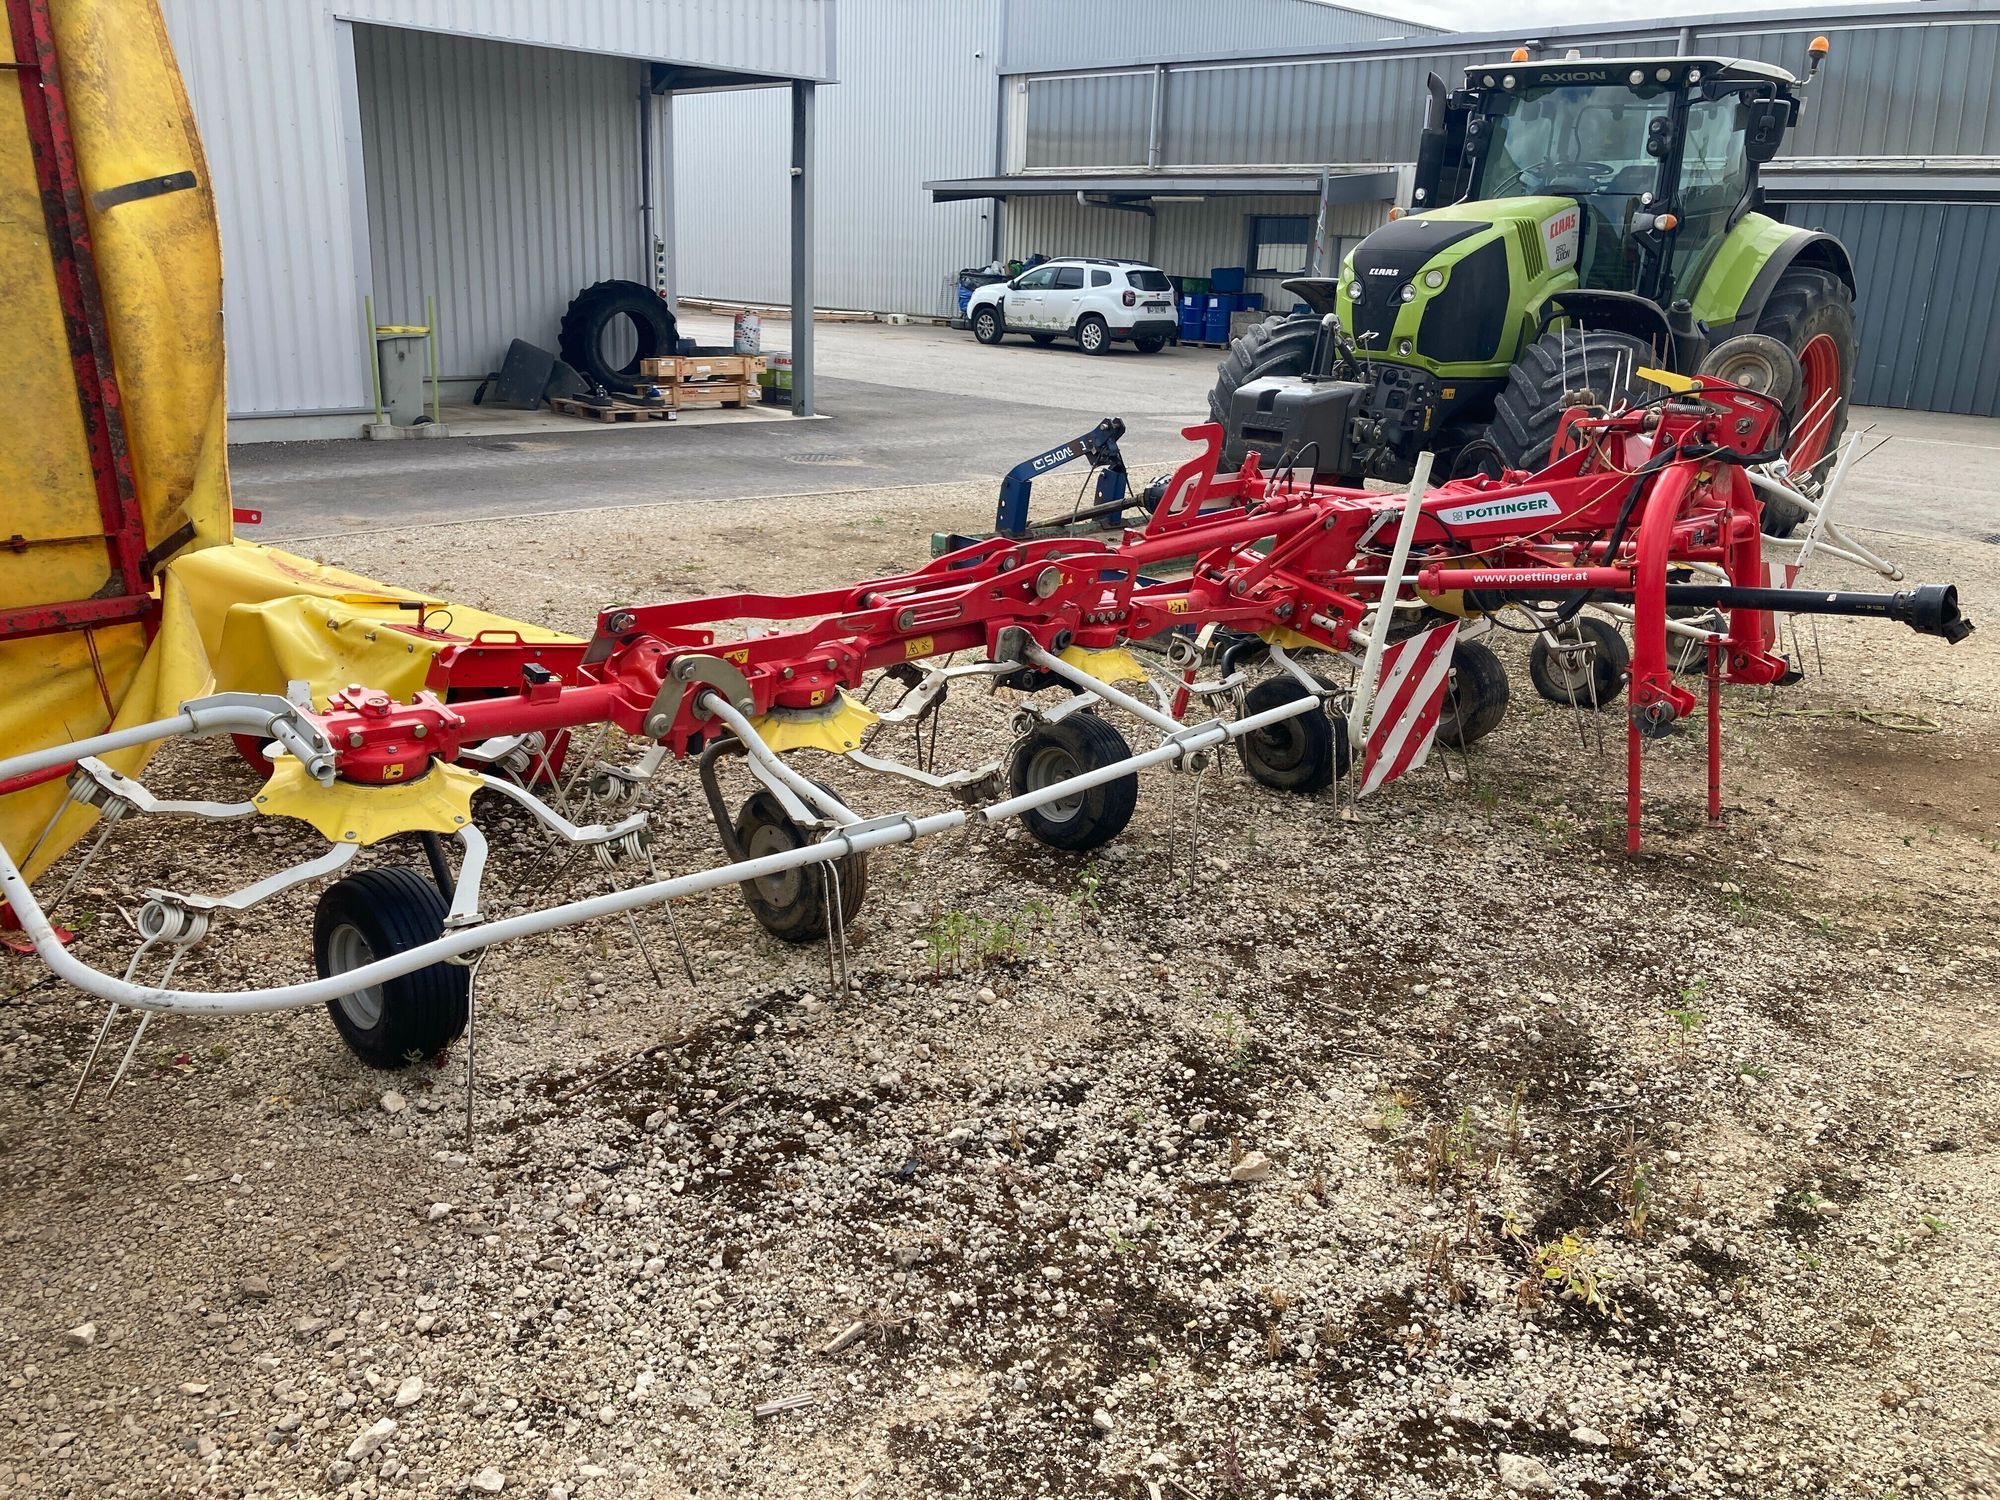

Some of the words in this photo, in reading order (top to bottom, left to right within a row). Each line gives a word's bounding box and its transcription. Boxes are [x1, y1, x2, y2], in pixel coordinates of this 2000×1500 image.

[1540, 72, 1606, 82] AXION
[1550, 214, 1576, 240] CLAAS
[1369, 268, 1399, 276] CLAAS
[1473, 571, 1588, 584] www.poettinger.at
